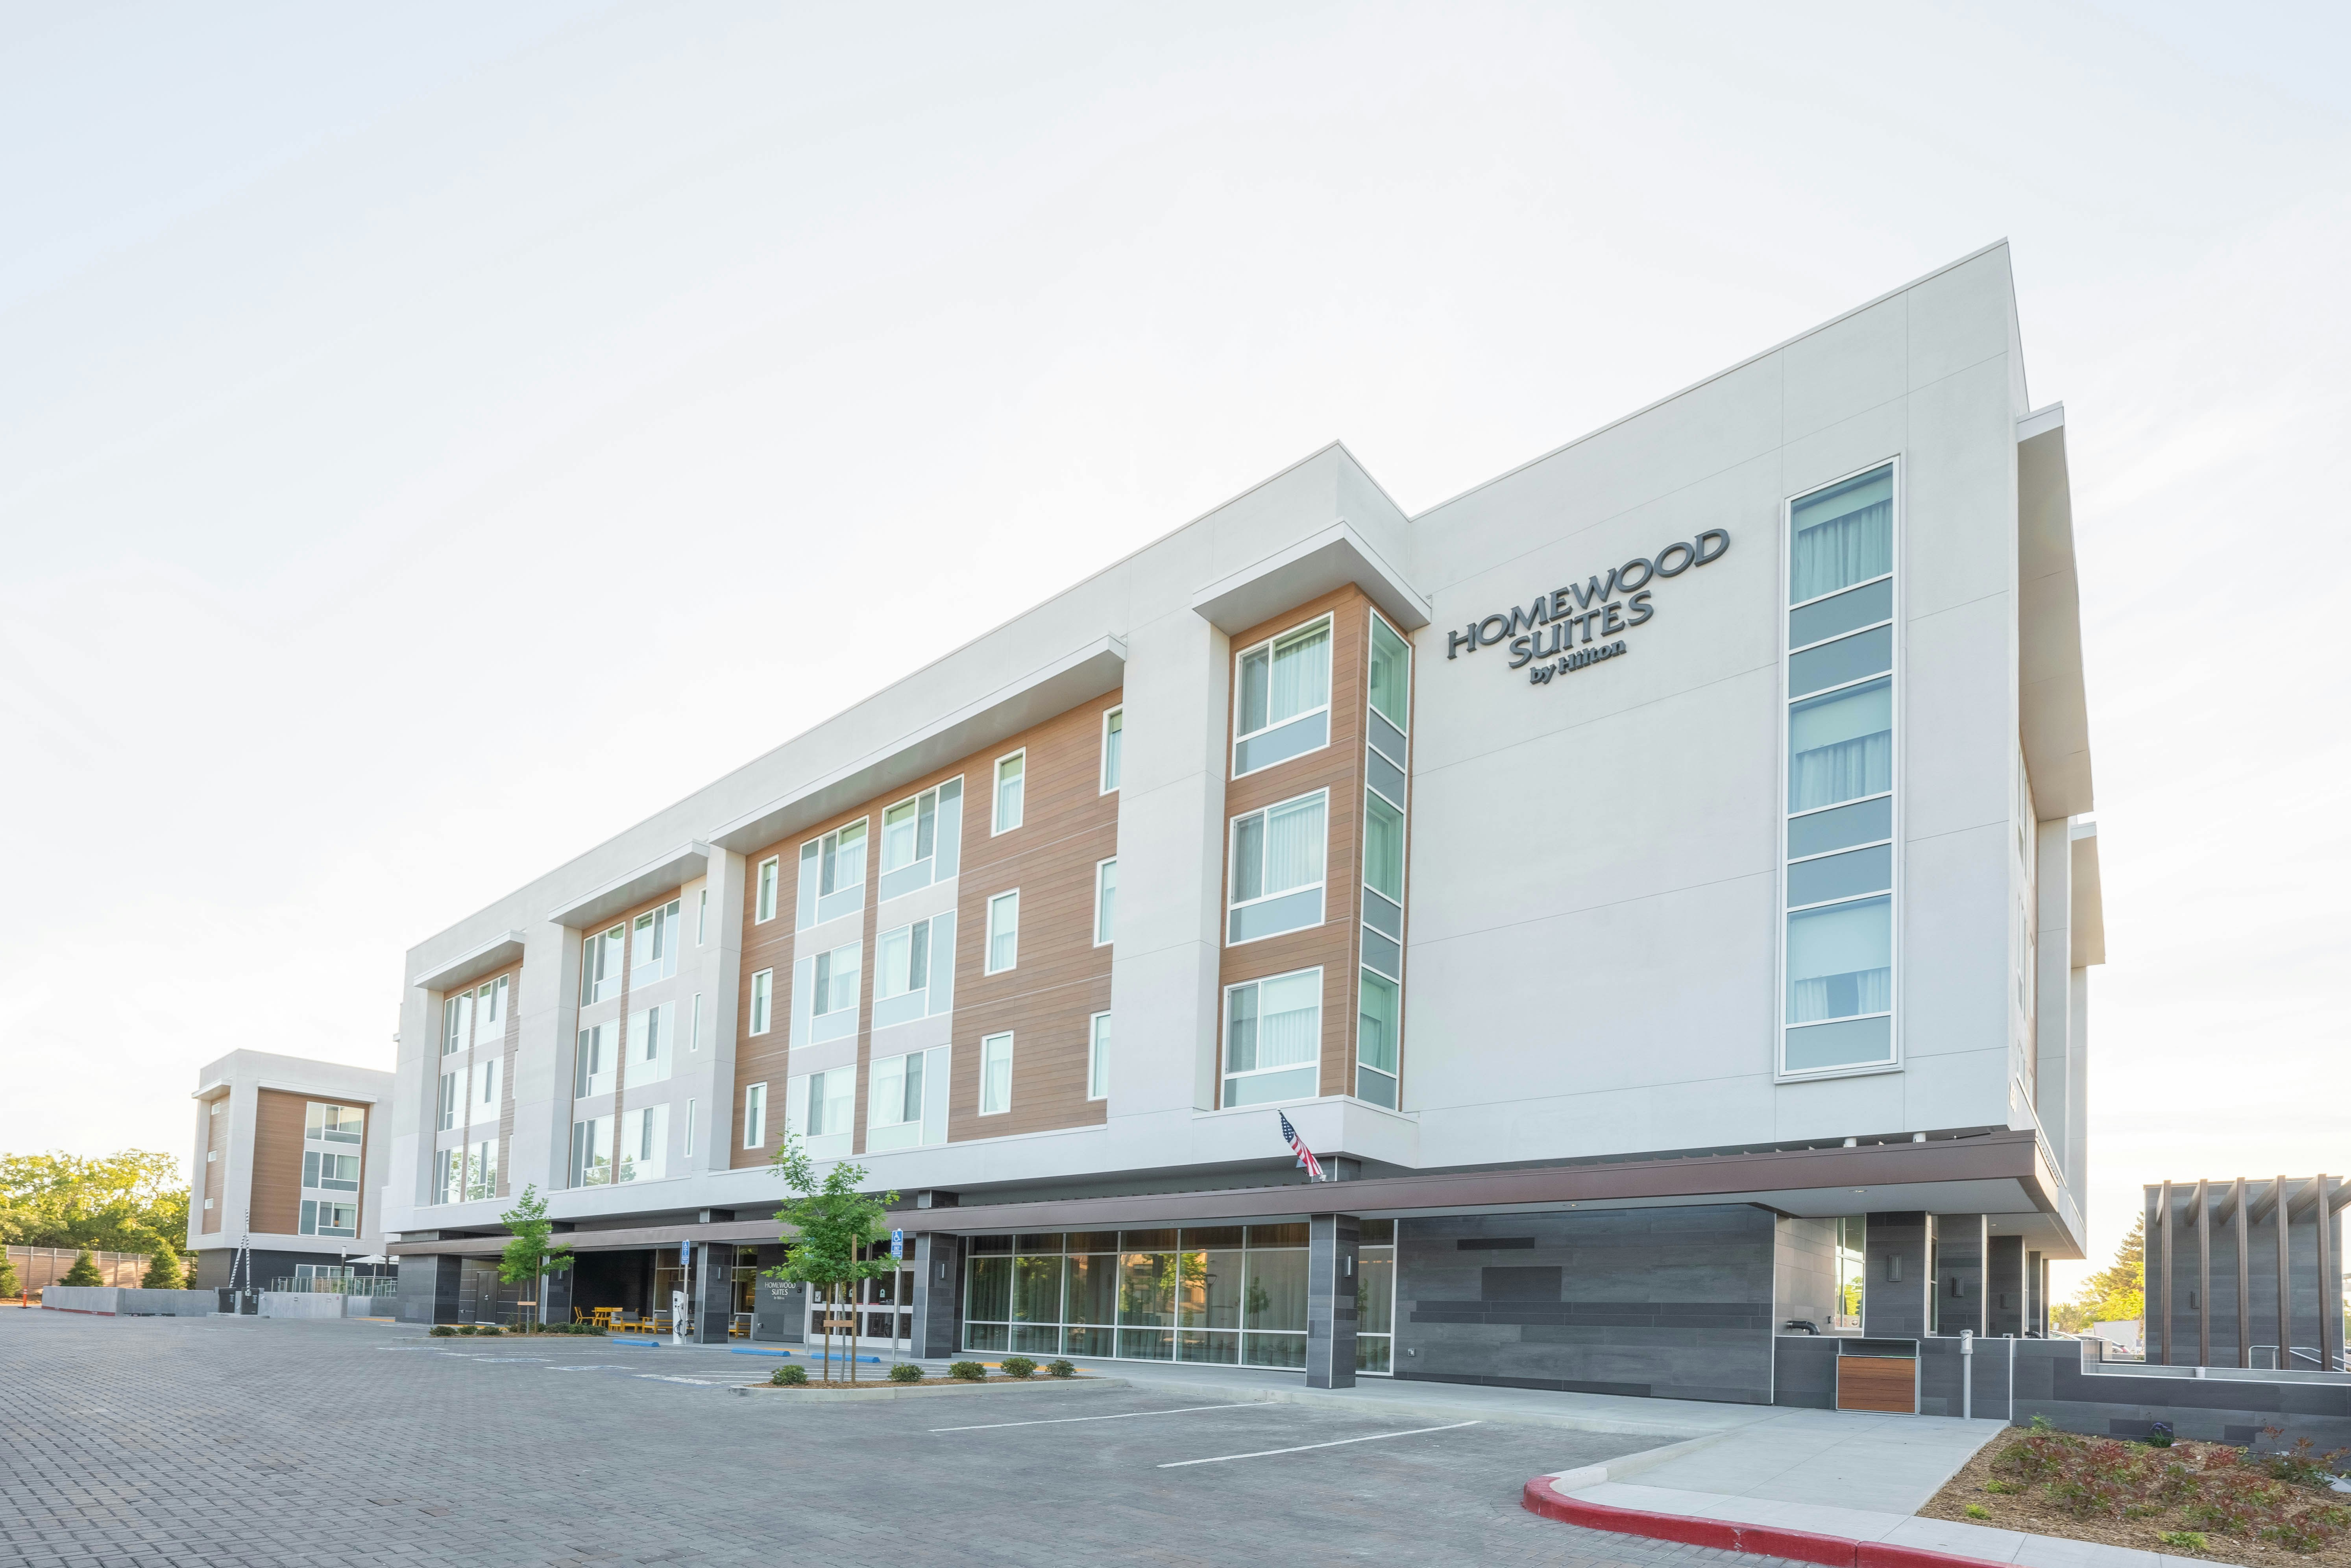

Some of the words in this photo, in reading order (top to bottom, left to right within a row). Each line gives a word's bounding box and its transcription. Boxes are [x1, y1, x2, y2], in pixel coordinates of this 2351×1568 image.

[1447, 528, 1730, 660] HOMEWOOD
[1508, 589, 1654, 670] SUITES
[1529, 663, 1557, 685] by
[1558, 639, 1628, 676] Hilton
